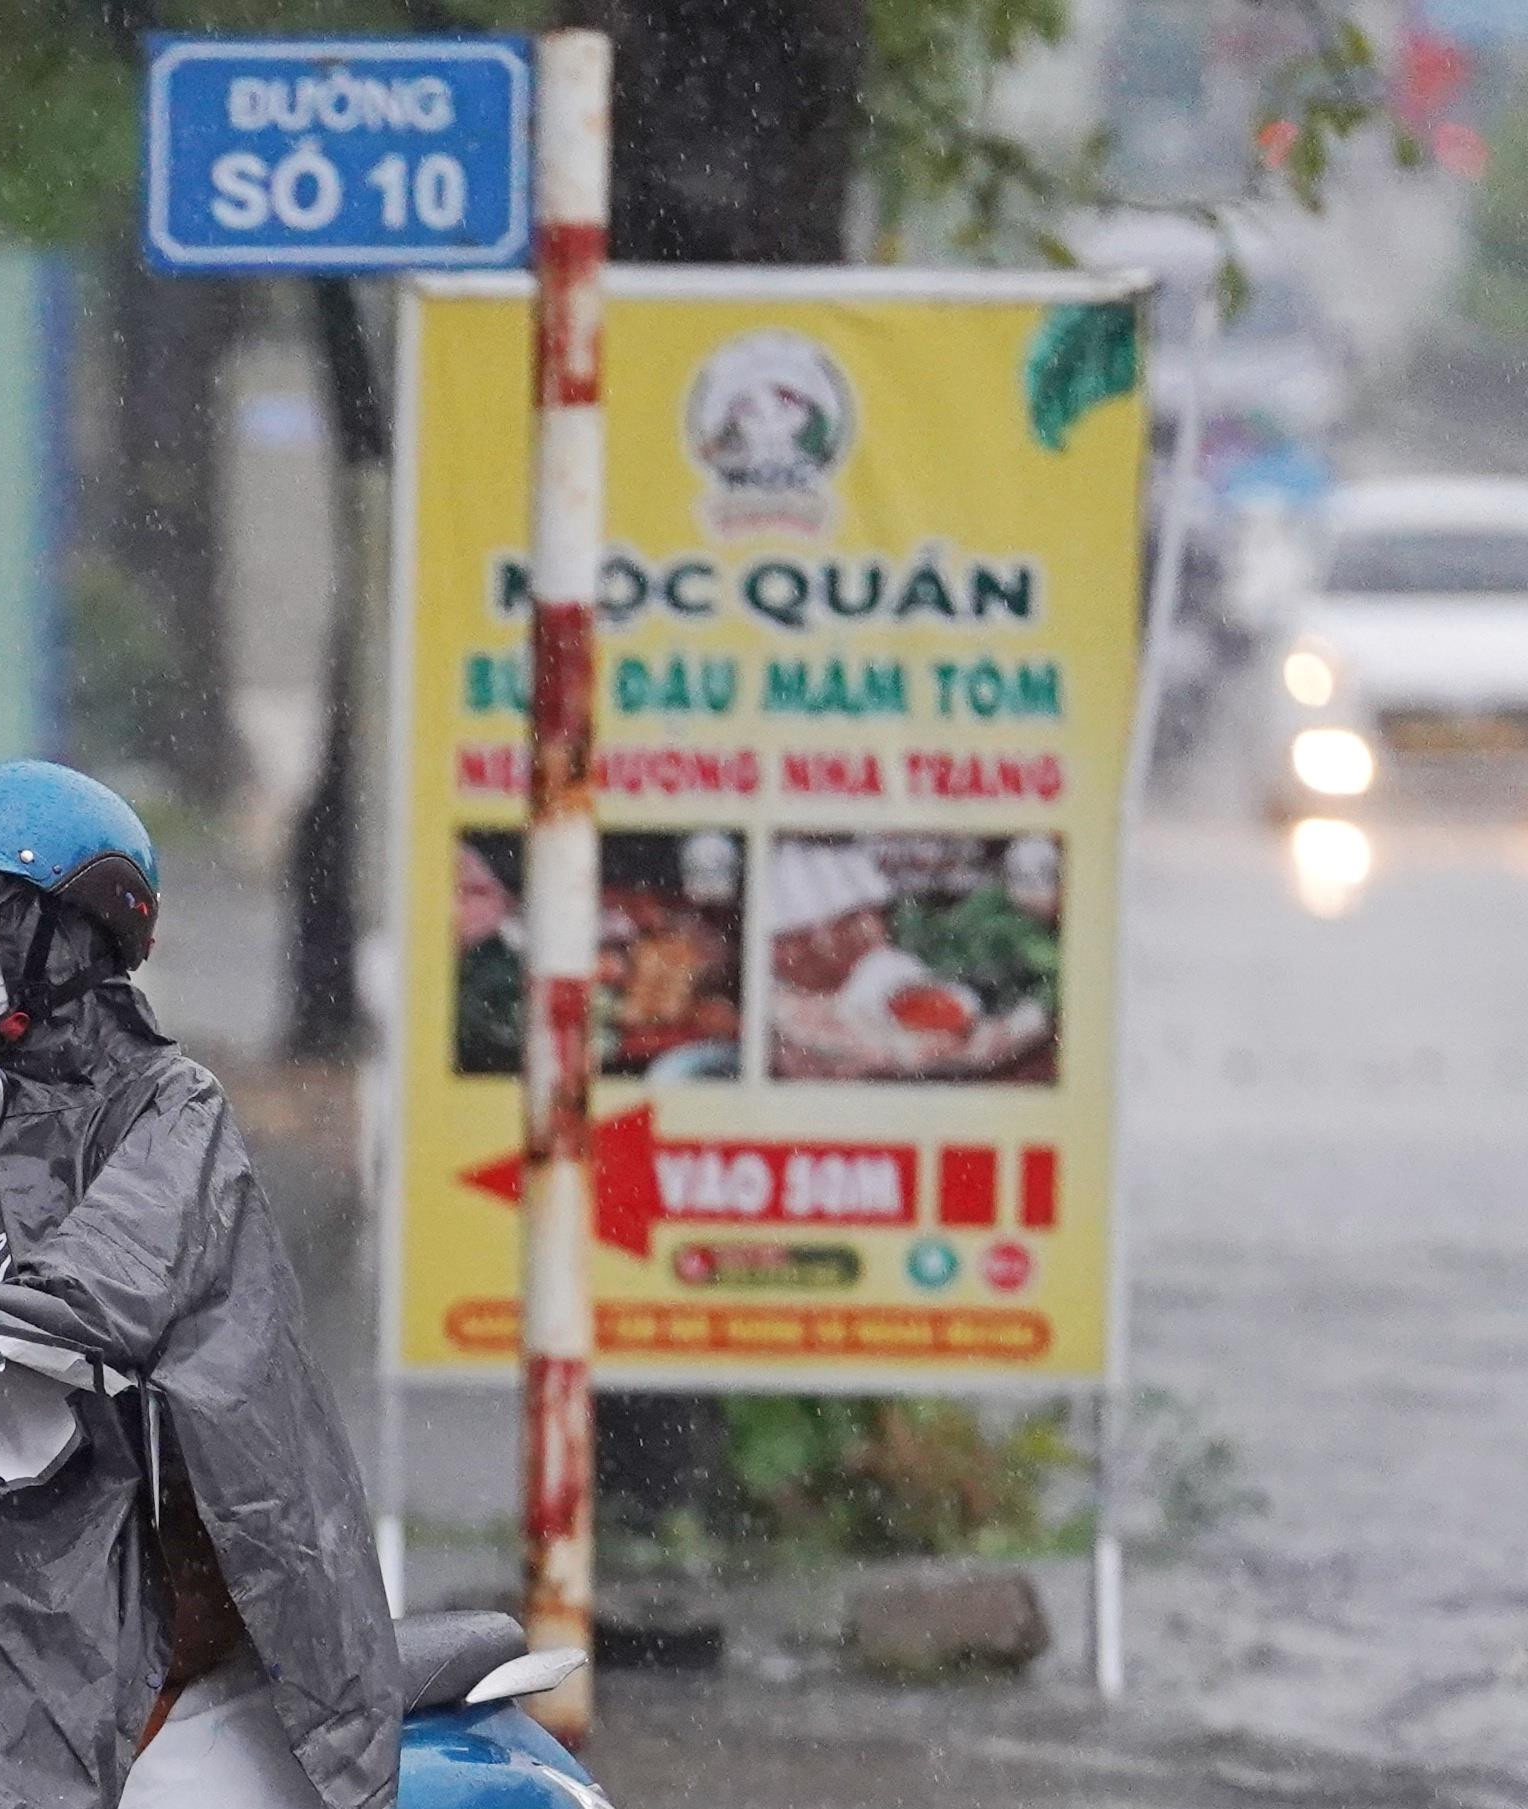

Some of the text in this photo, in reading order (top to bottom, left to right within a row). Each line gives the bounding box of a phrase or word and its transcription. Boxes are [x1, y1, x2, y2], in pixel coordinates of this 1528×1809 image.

[226, 68, 455, 133] ĐƯỜNG
[210, 138, 466, 230] SỐ 10
[744, 544, 1032, 628] QUÁN
